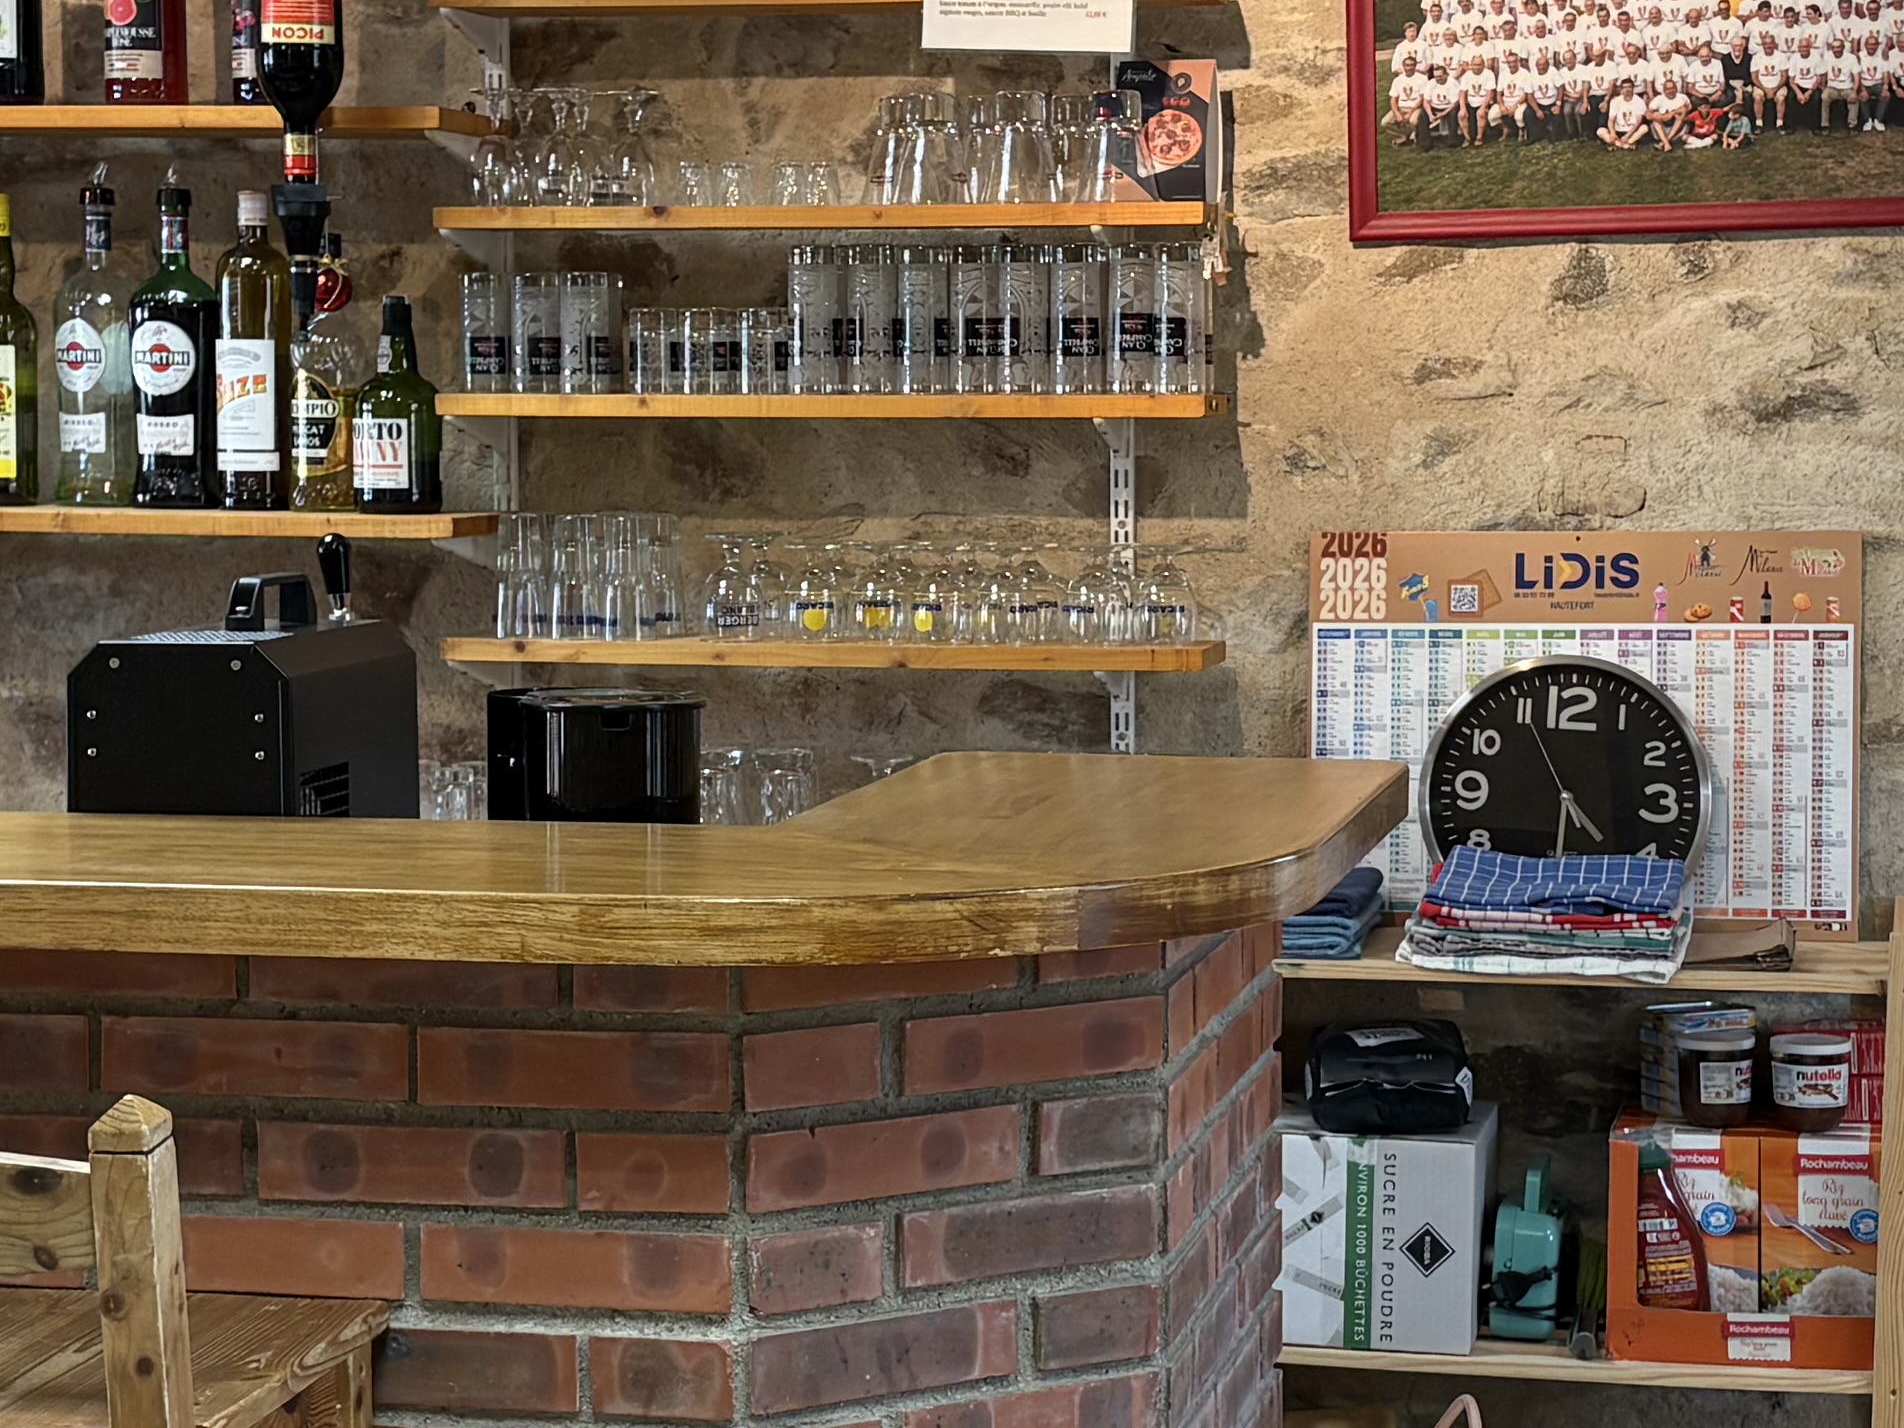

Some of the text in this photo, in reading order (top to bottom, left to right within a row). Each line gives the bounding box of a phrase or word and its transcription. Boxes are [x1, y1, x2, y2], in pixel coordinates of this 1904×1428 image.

[272, 27, 325, 40] PICON
[57, 349, 102, 363] MARTINI
[135, 350, 191, 366] MARTINI
[353, 422, 403, 441] ORTO
[1321, 532, 1388, 558] 2026
[1320, 557, 1388, 590] 2026
[1320, 588, 1388, 620] 2026
[1517, 697, 1533, 724] 11
[1546, 685, 1598, 732] 12
[1618, 704, 1626, 731] 1
[1472, 728, 1501, 756] 10
[1643, 740, 1666, 767] 2
[1454, 770, 1489, 811] 9
[1638, 783, 1679, 823] 3
[1466, 829, 1492, 851] 8
[1796, 1068, 1842, 1082] nutella
[1672, 1152, 1720, 1165] hambeau
[1800, 1157, 1869, 1171] Rochambeau
[1356, 1162, 1368, 1218] NVIRON
[1831, 1196, 1865, 1209] grain
[1356, 1224, 1367, 1254] 1000
[1380, 1153, 1397, 1343] SUCRE EN POUDRE
[1729, 1324, 1790, 1335] Rochambeau
